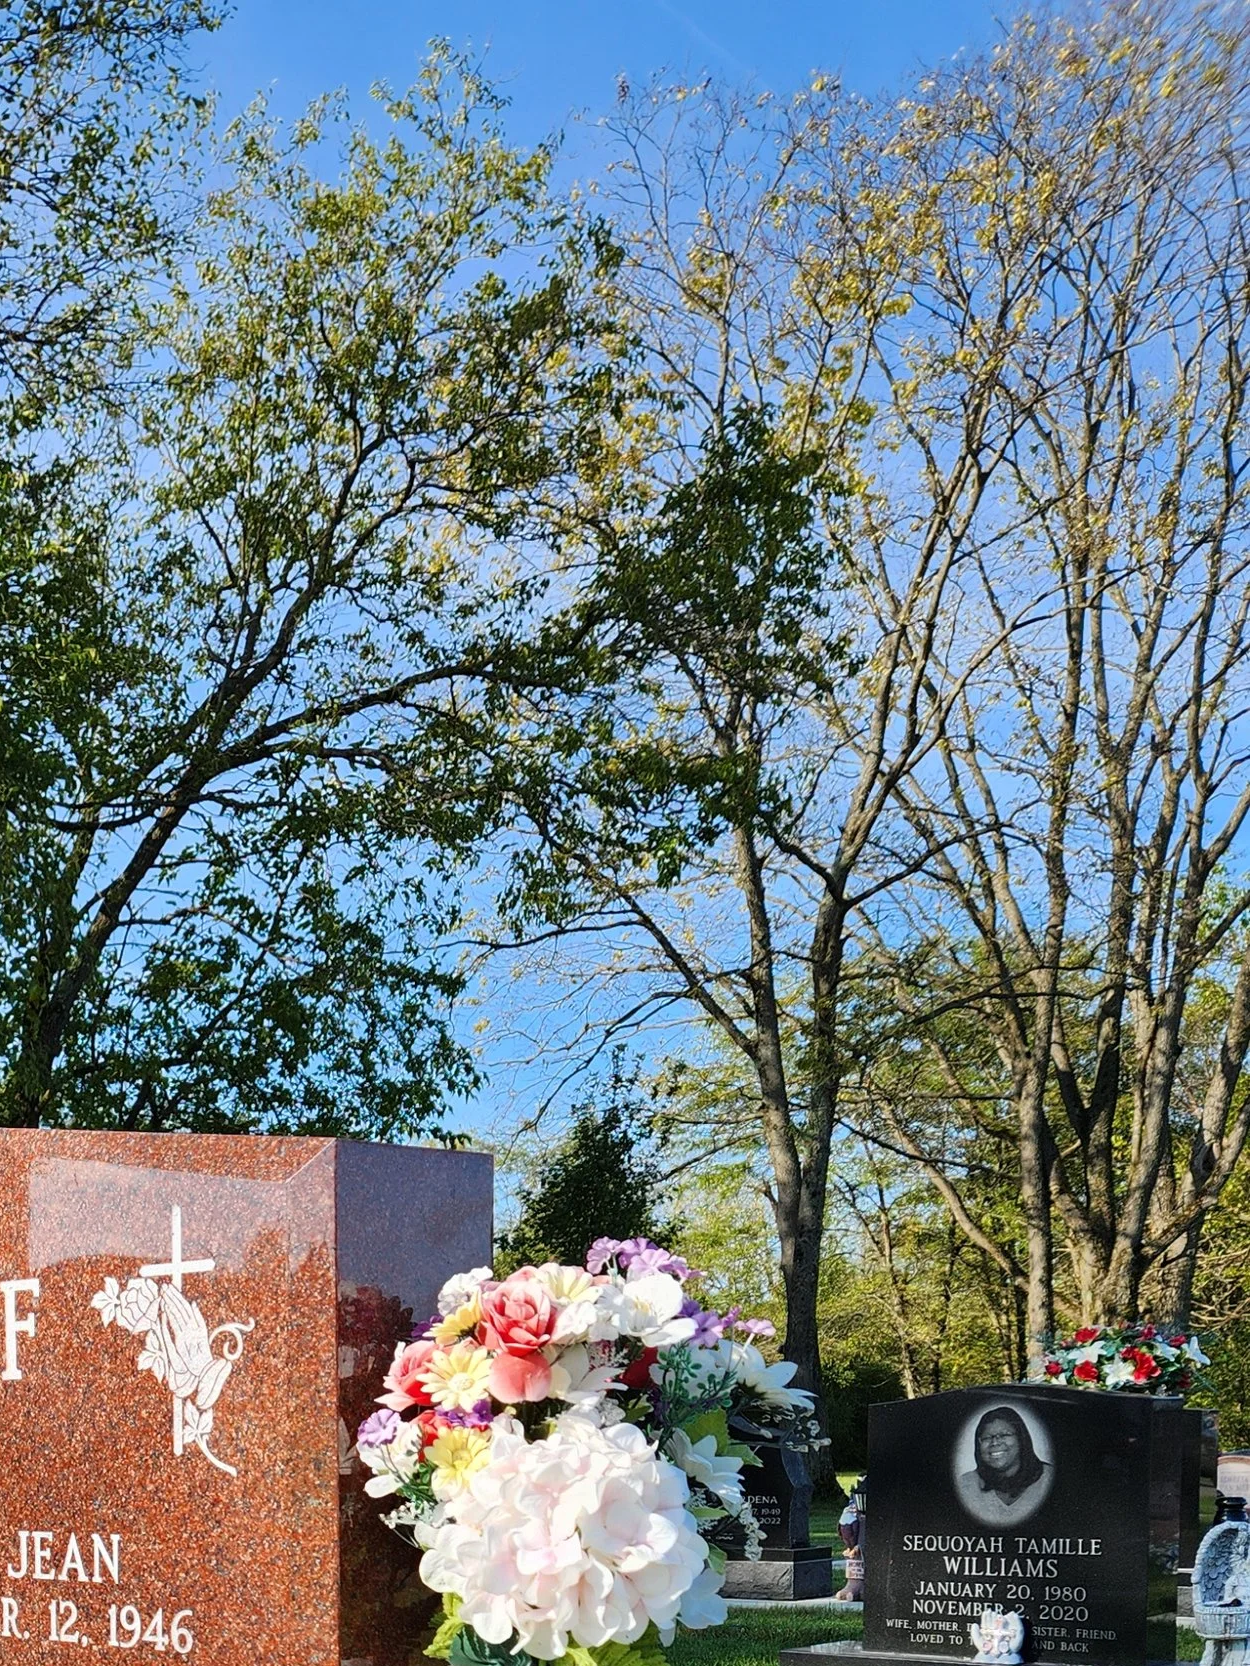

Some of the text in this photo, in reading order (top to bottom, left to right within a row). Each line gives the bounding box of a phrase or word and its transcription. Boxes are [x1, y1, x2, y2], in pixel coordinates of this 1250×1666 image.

[903, 1535, 1102, 1556] SEQUOYAH TAMILLE
[7, 1530, 121, 1584] JEAN
[943, 1556, 1058, 1578] WILLIAMS
[915, 1581, 997, 1598] JANUARY
[1044, 1586, 1086, 1602] 1980
[1038, 1605, 1089, 1622] 2020
[49, 1600, 89, 1648] 12,
[109, 1603, 194, 1654] 1946
[910, 1633, 944, 1644] LOVED
[949, 1635, 963, 1645] TO
[1031, 1640, 1055, 1650] AND
[1060, 1641, 1089, 1653] BACK
